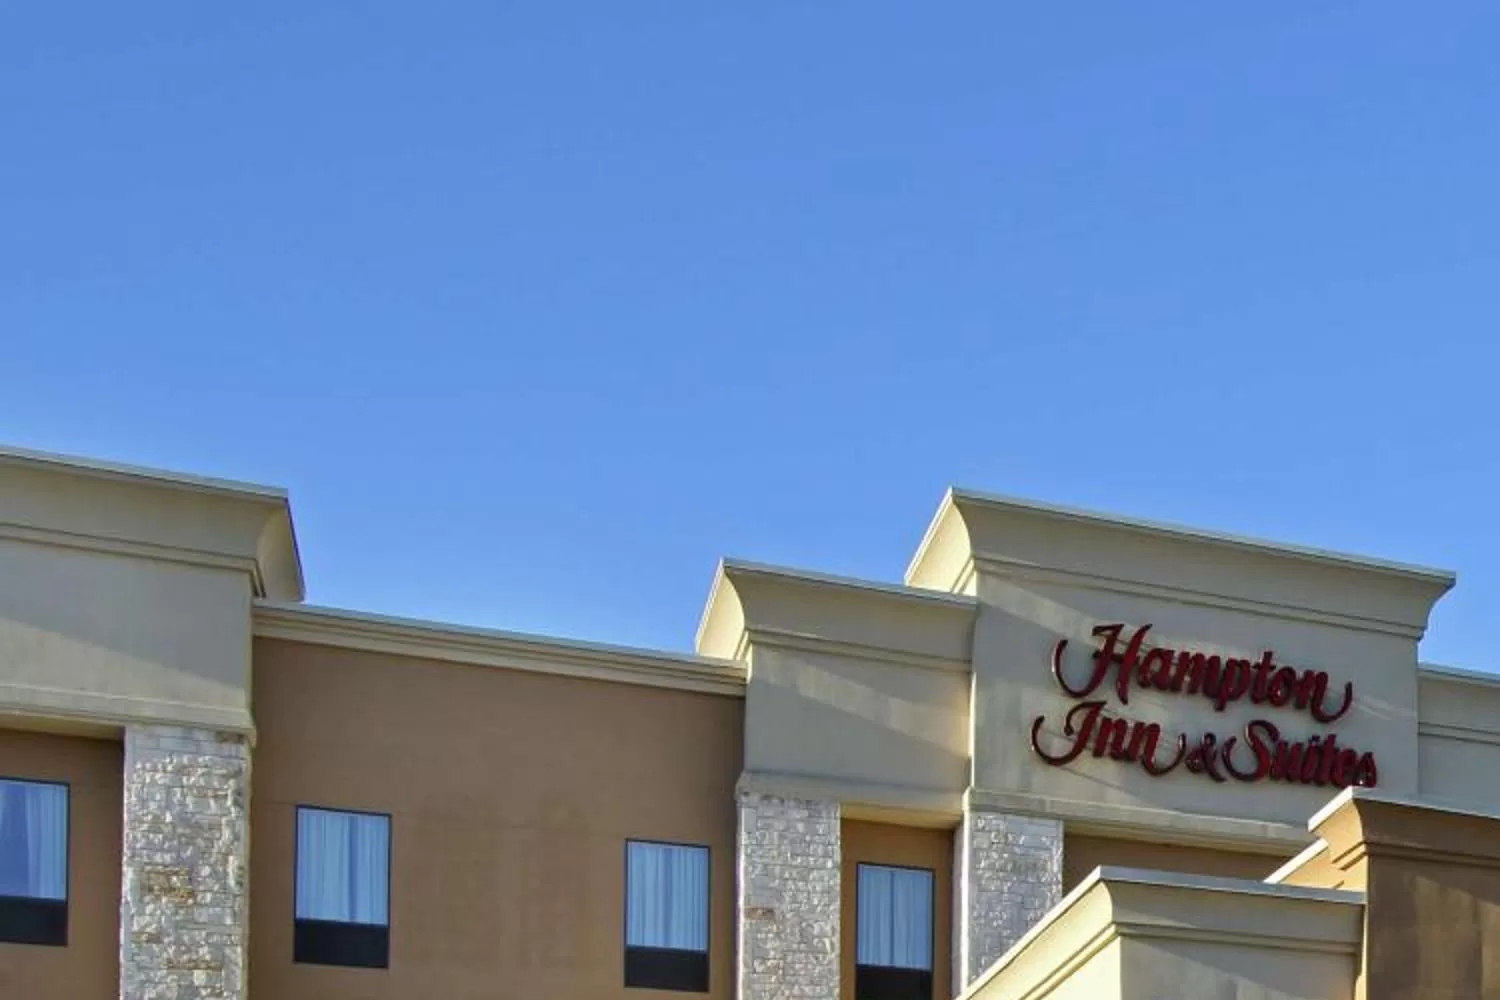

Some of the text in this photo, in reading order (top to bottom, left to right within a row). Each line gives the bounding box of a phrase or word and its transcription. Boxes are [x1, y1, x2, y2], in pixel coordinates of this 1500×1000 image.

[1051, 623, 1353, 723] Hampton
[1031, 701, 1378, 788] Inn & Suites
